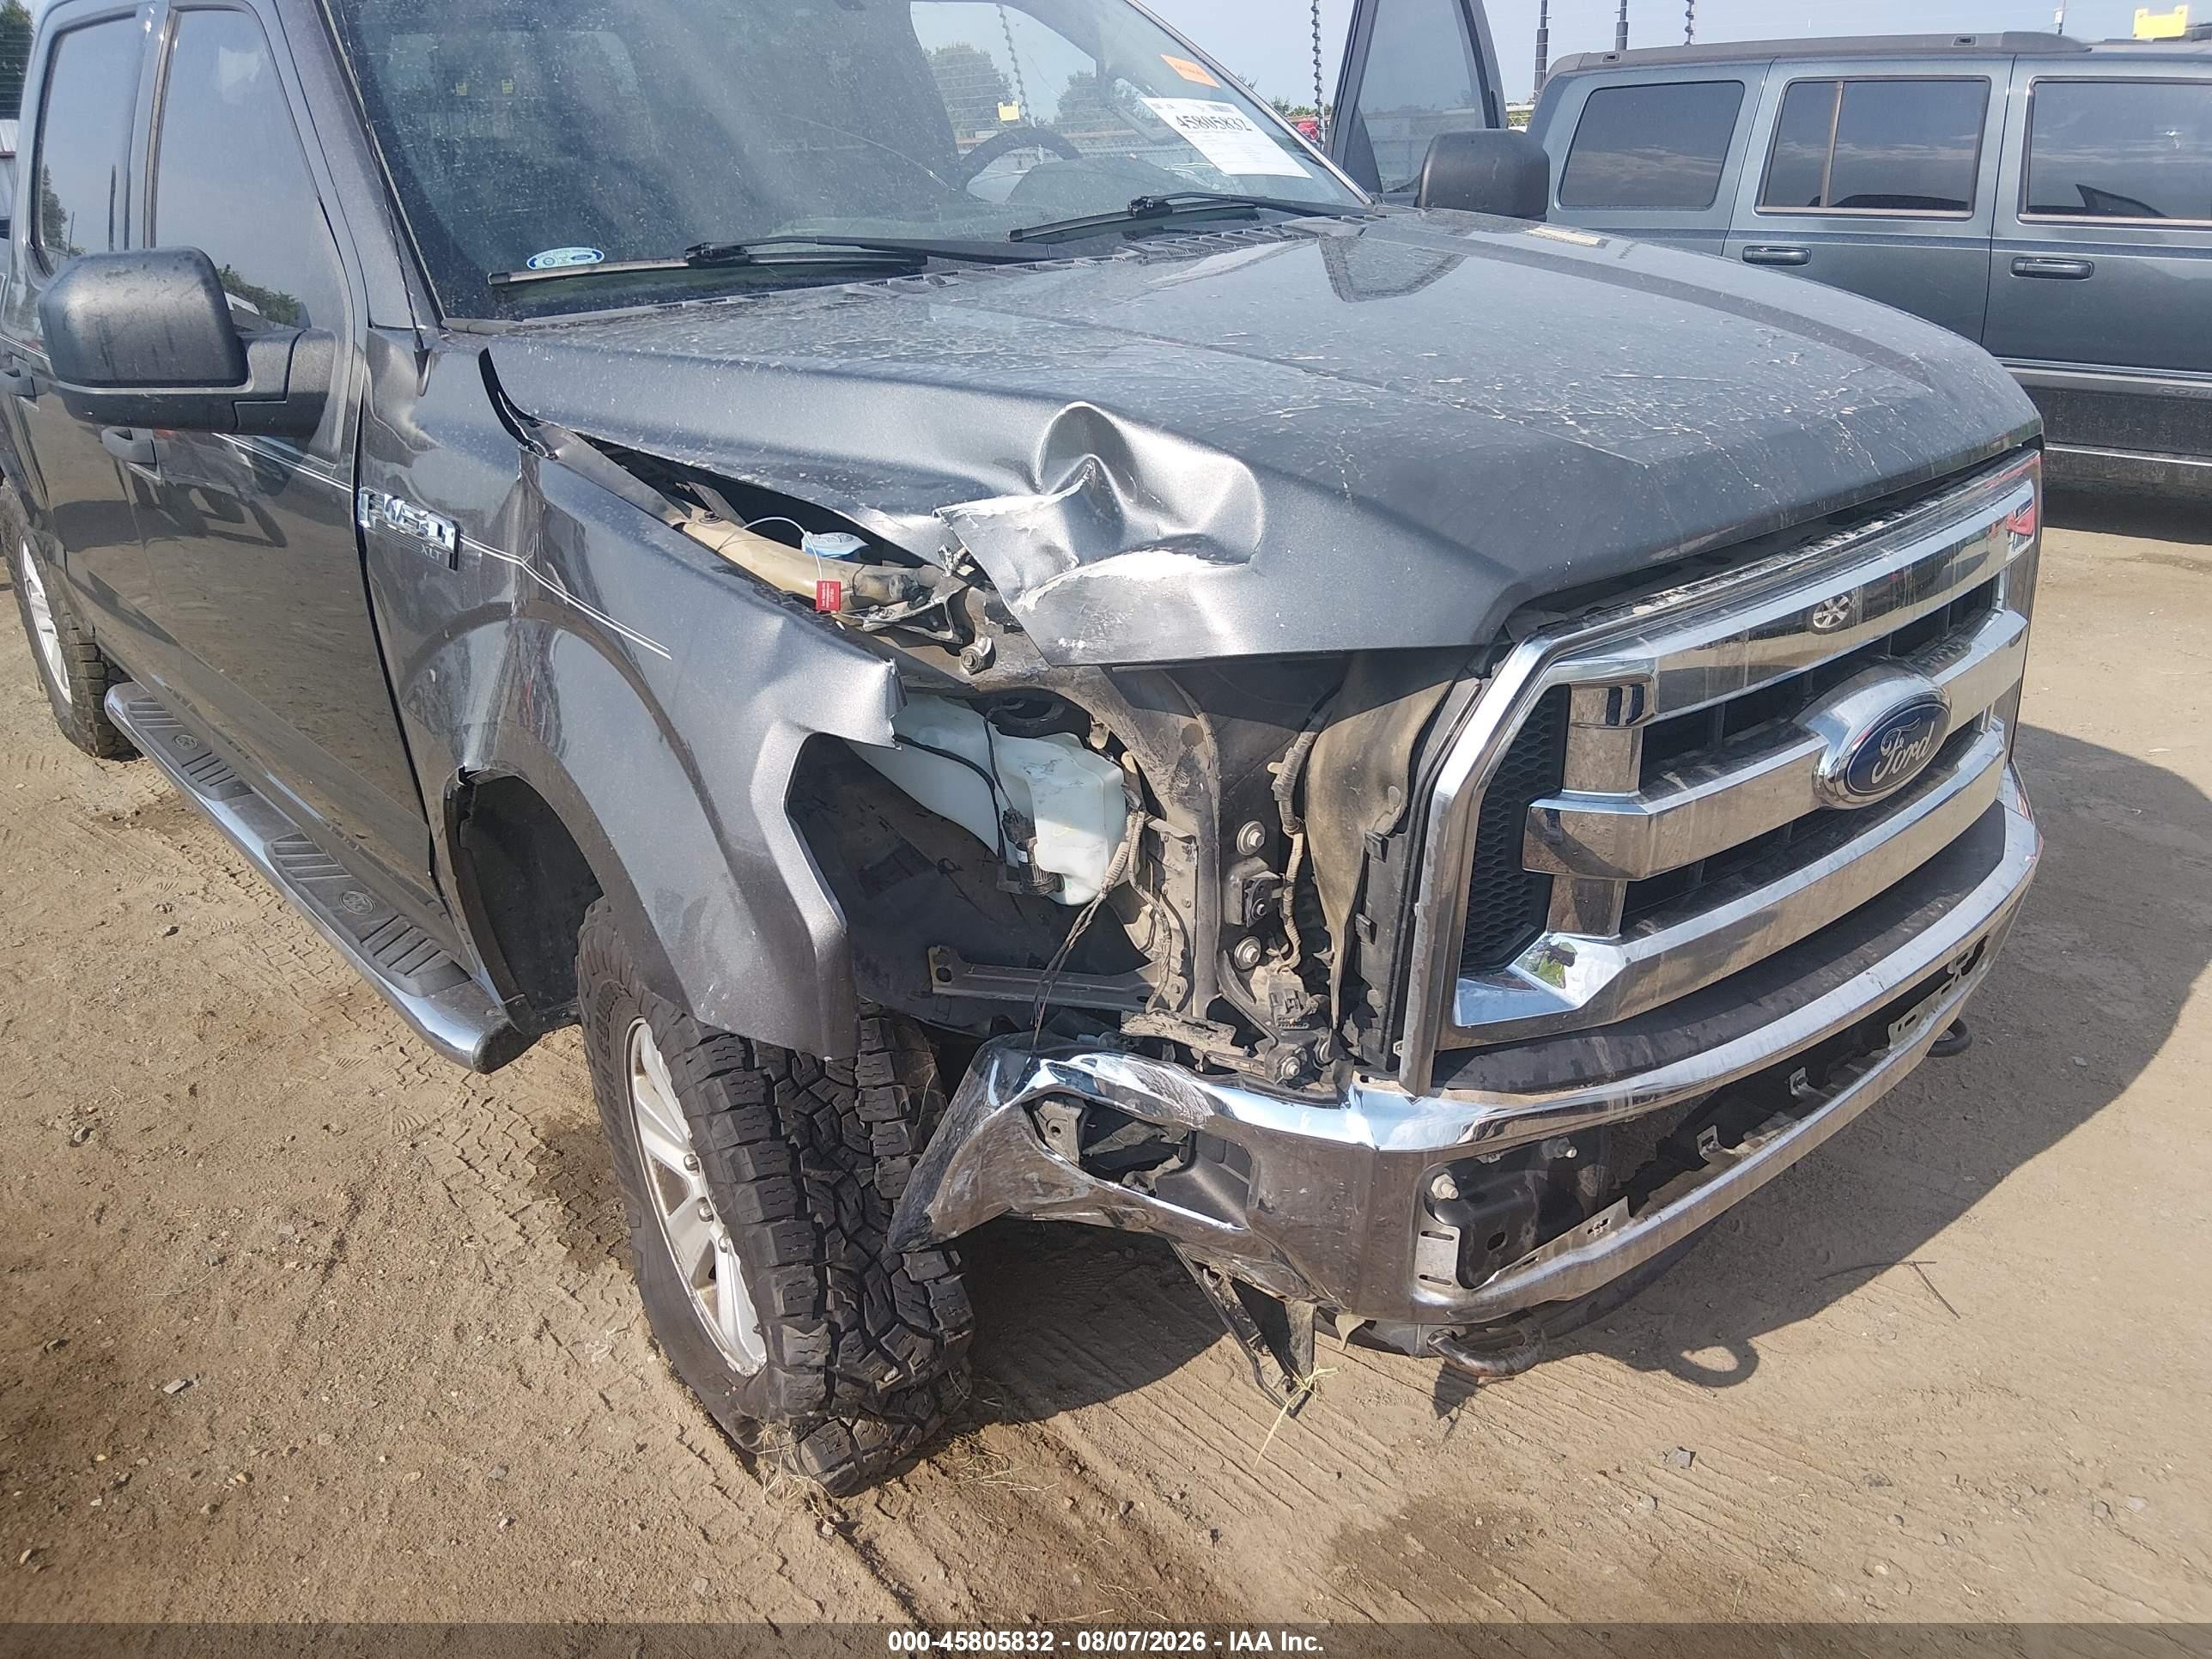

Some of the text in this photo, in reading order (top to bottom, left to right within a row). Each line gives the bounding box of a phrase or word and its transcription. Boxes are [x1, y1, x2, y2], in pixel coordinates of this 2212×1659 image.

[1176, 115, 1252, 131] 45805832
[421, 544, 443, 561] XLT
[1871, 716, 1936, 784] Ford
